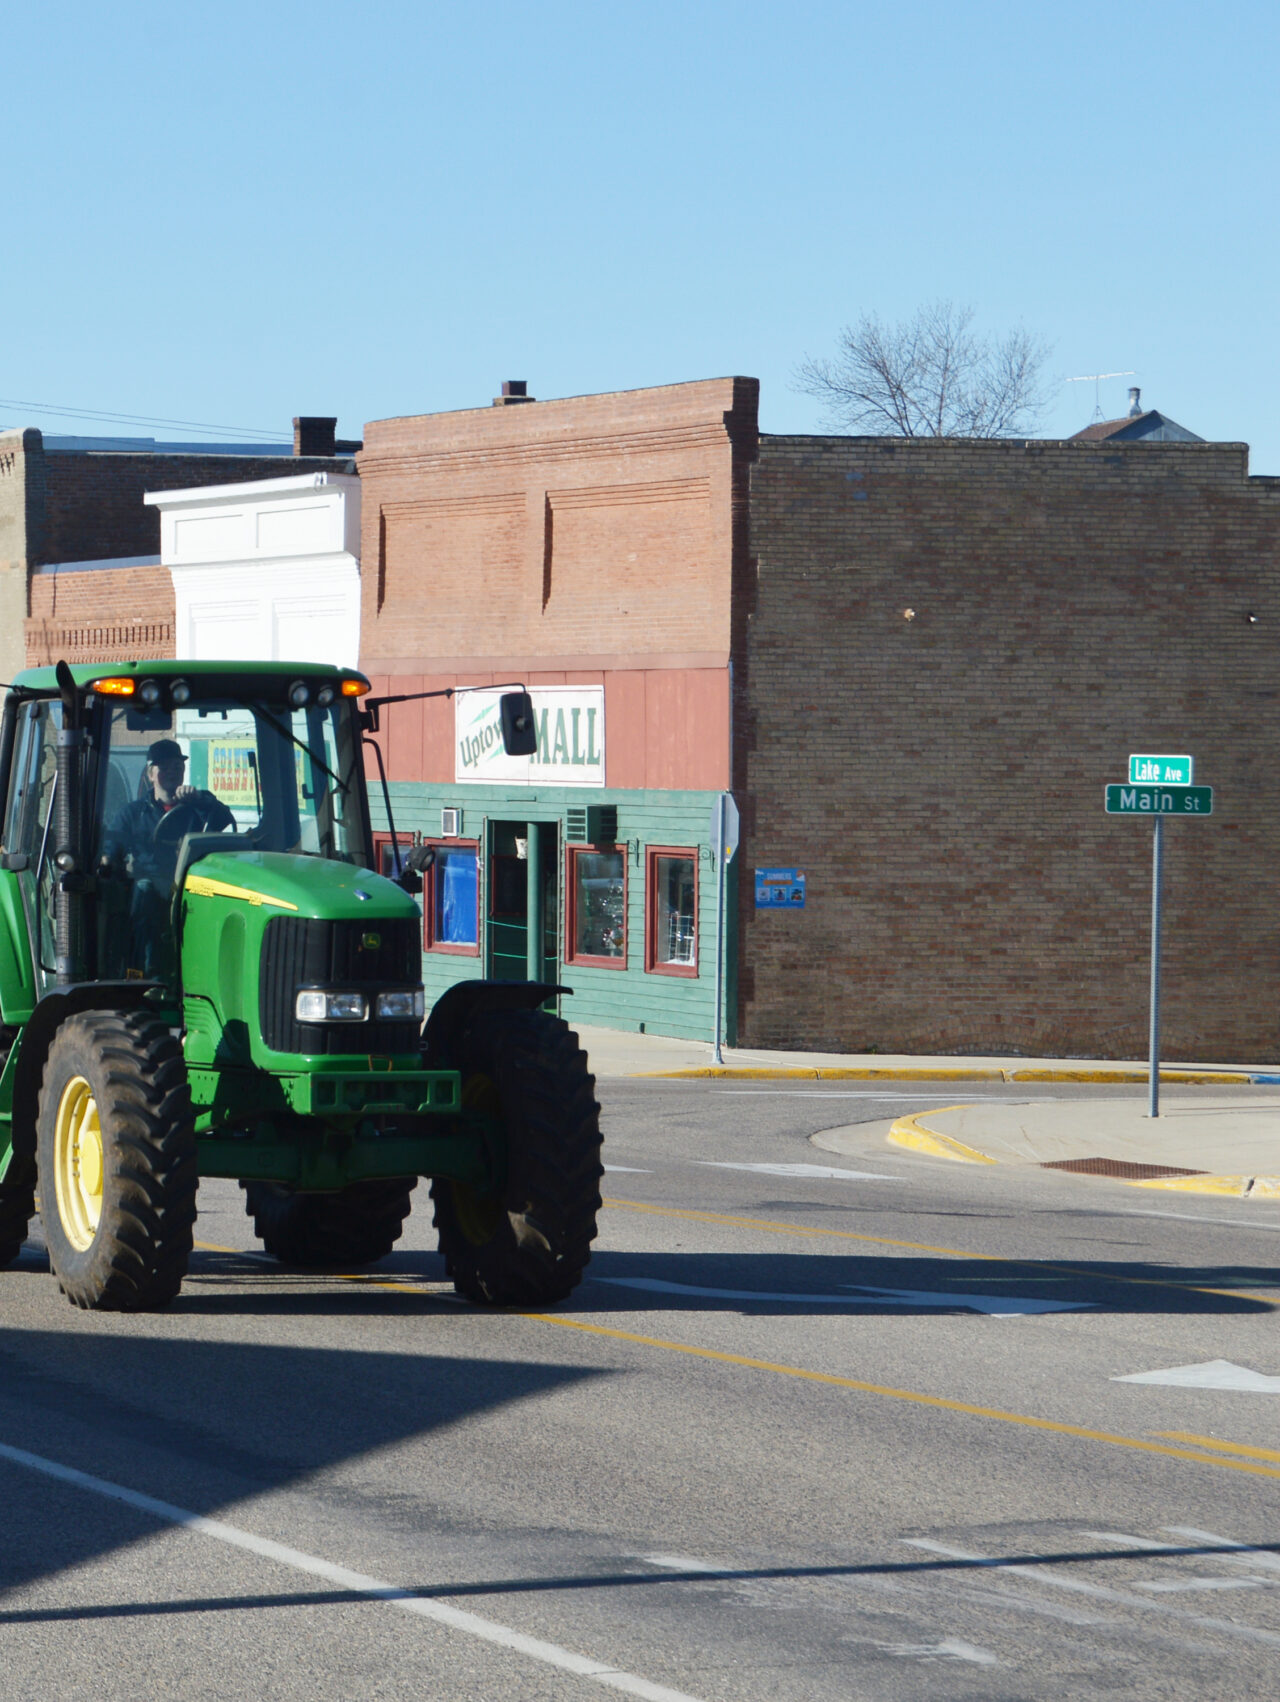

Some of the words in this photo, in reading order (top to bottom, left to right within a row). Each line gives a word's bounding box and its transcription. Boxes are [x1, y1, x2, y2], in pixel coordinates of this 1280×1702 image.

[460, 716, 504, 768] Uptow
[530, 708, 601, 766] MALL
[1135, 759, 1160, 781] Lake
[1164, 766, 1183, 781] Ave
[1120, 789, 1173, 810] Main
[1184, 796, 1200, 810] St
